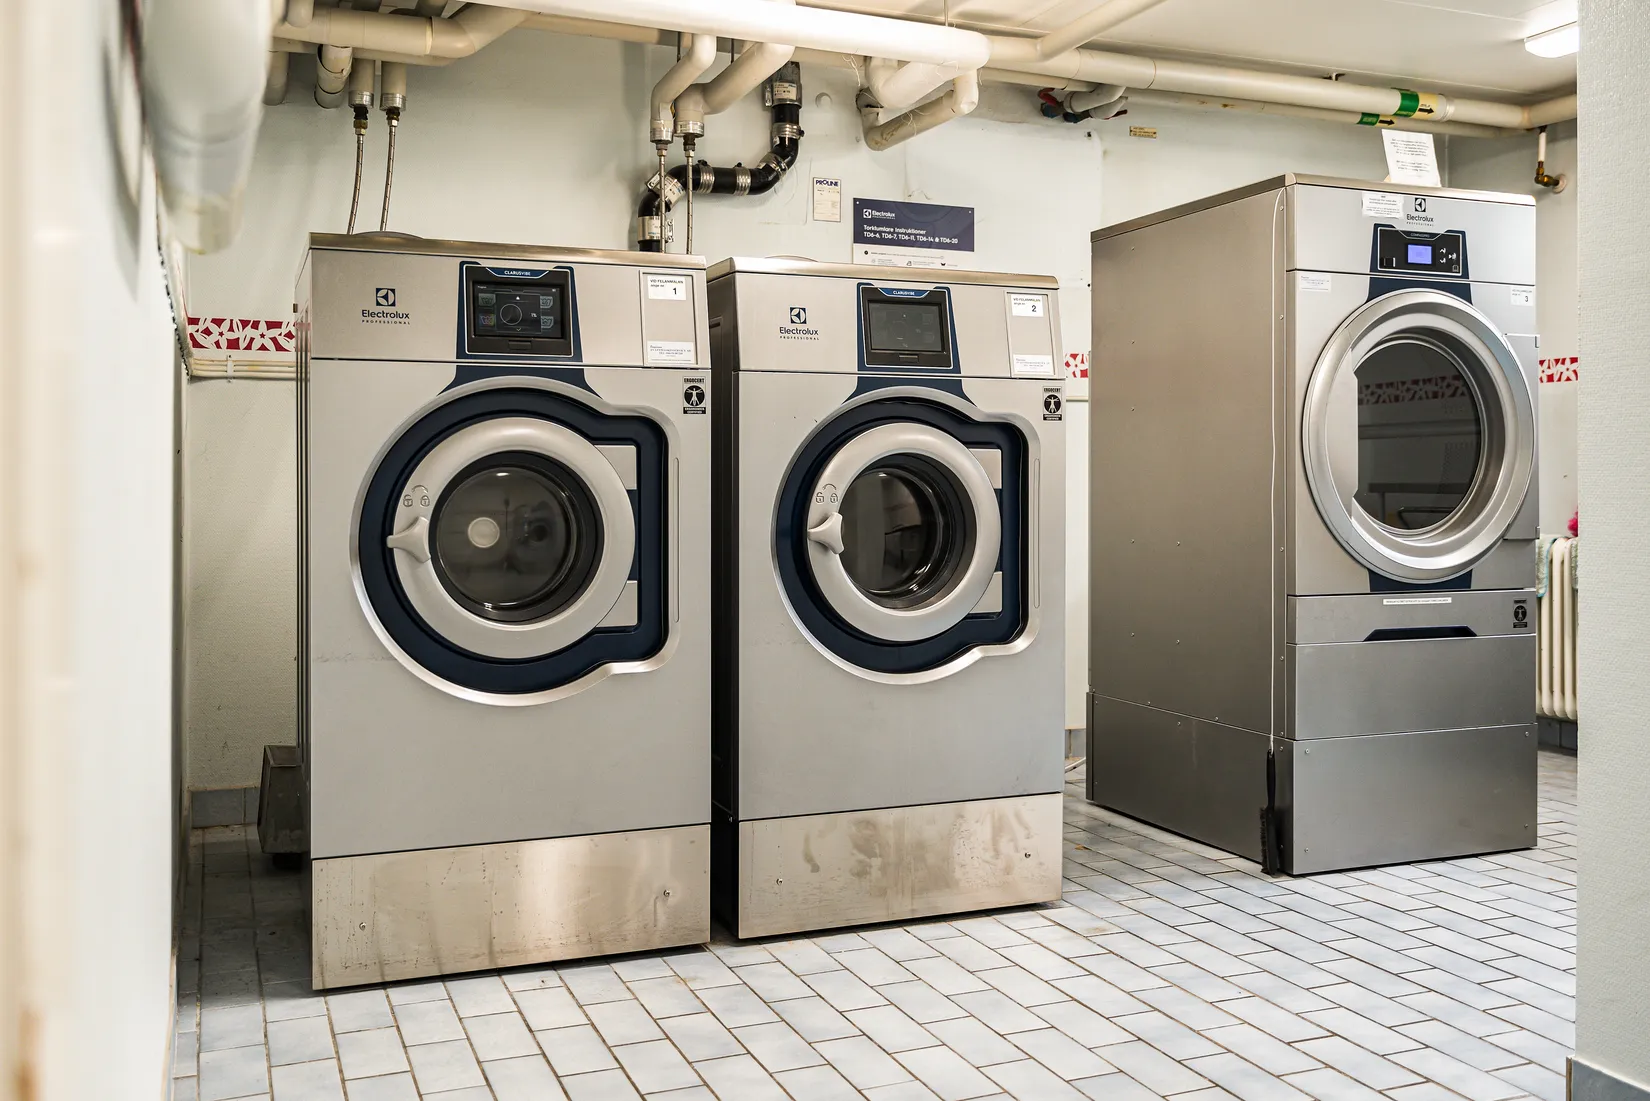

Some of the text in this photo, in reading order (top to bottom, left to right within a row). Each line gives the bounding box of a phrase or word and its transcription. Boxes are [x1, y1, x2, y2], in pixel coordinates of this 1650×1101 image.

[815, 179, 839, 187] PROLINE
[1406, 213, 1434, 222] Electrolux
[863, 224, 927, 235] Torktumlare Instruktioner
[916, 235, 934, 243] TD6-14
[672, 287, 677, 295] 1
[1524, 295, 1529, 303] 3
[1031, 304, 1037, 313] 2
[361, 309, 410, 320] Electrolux
[779, 326, 819, 336] Electrolux
